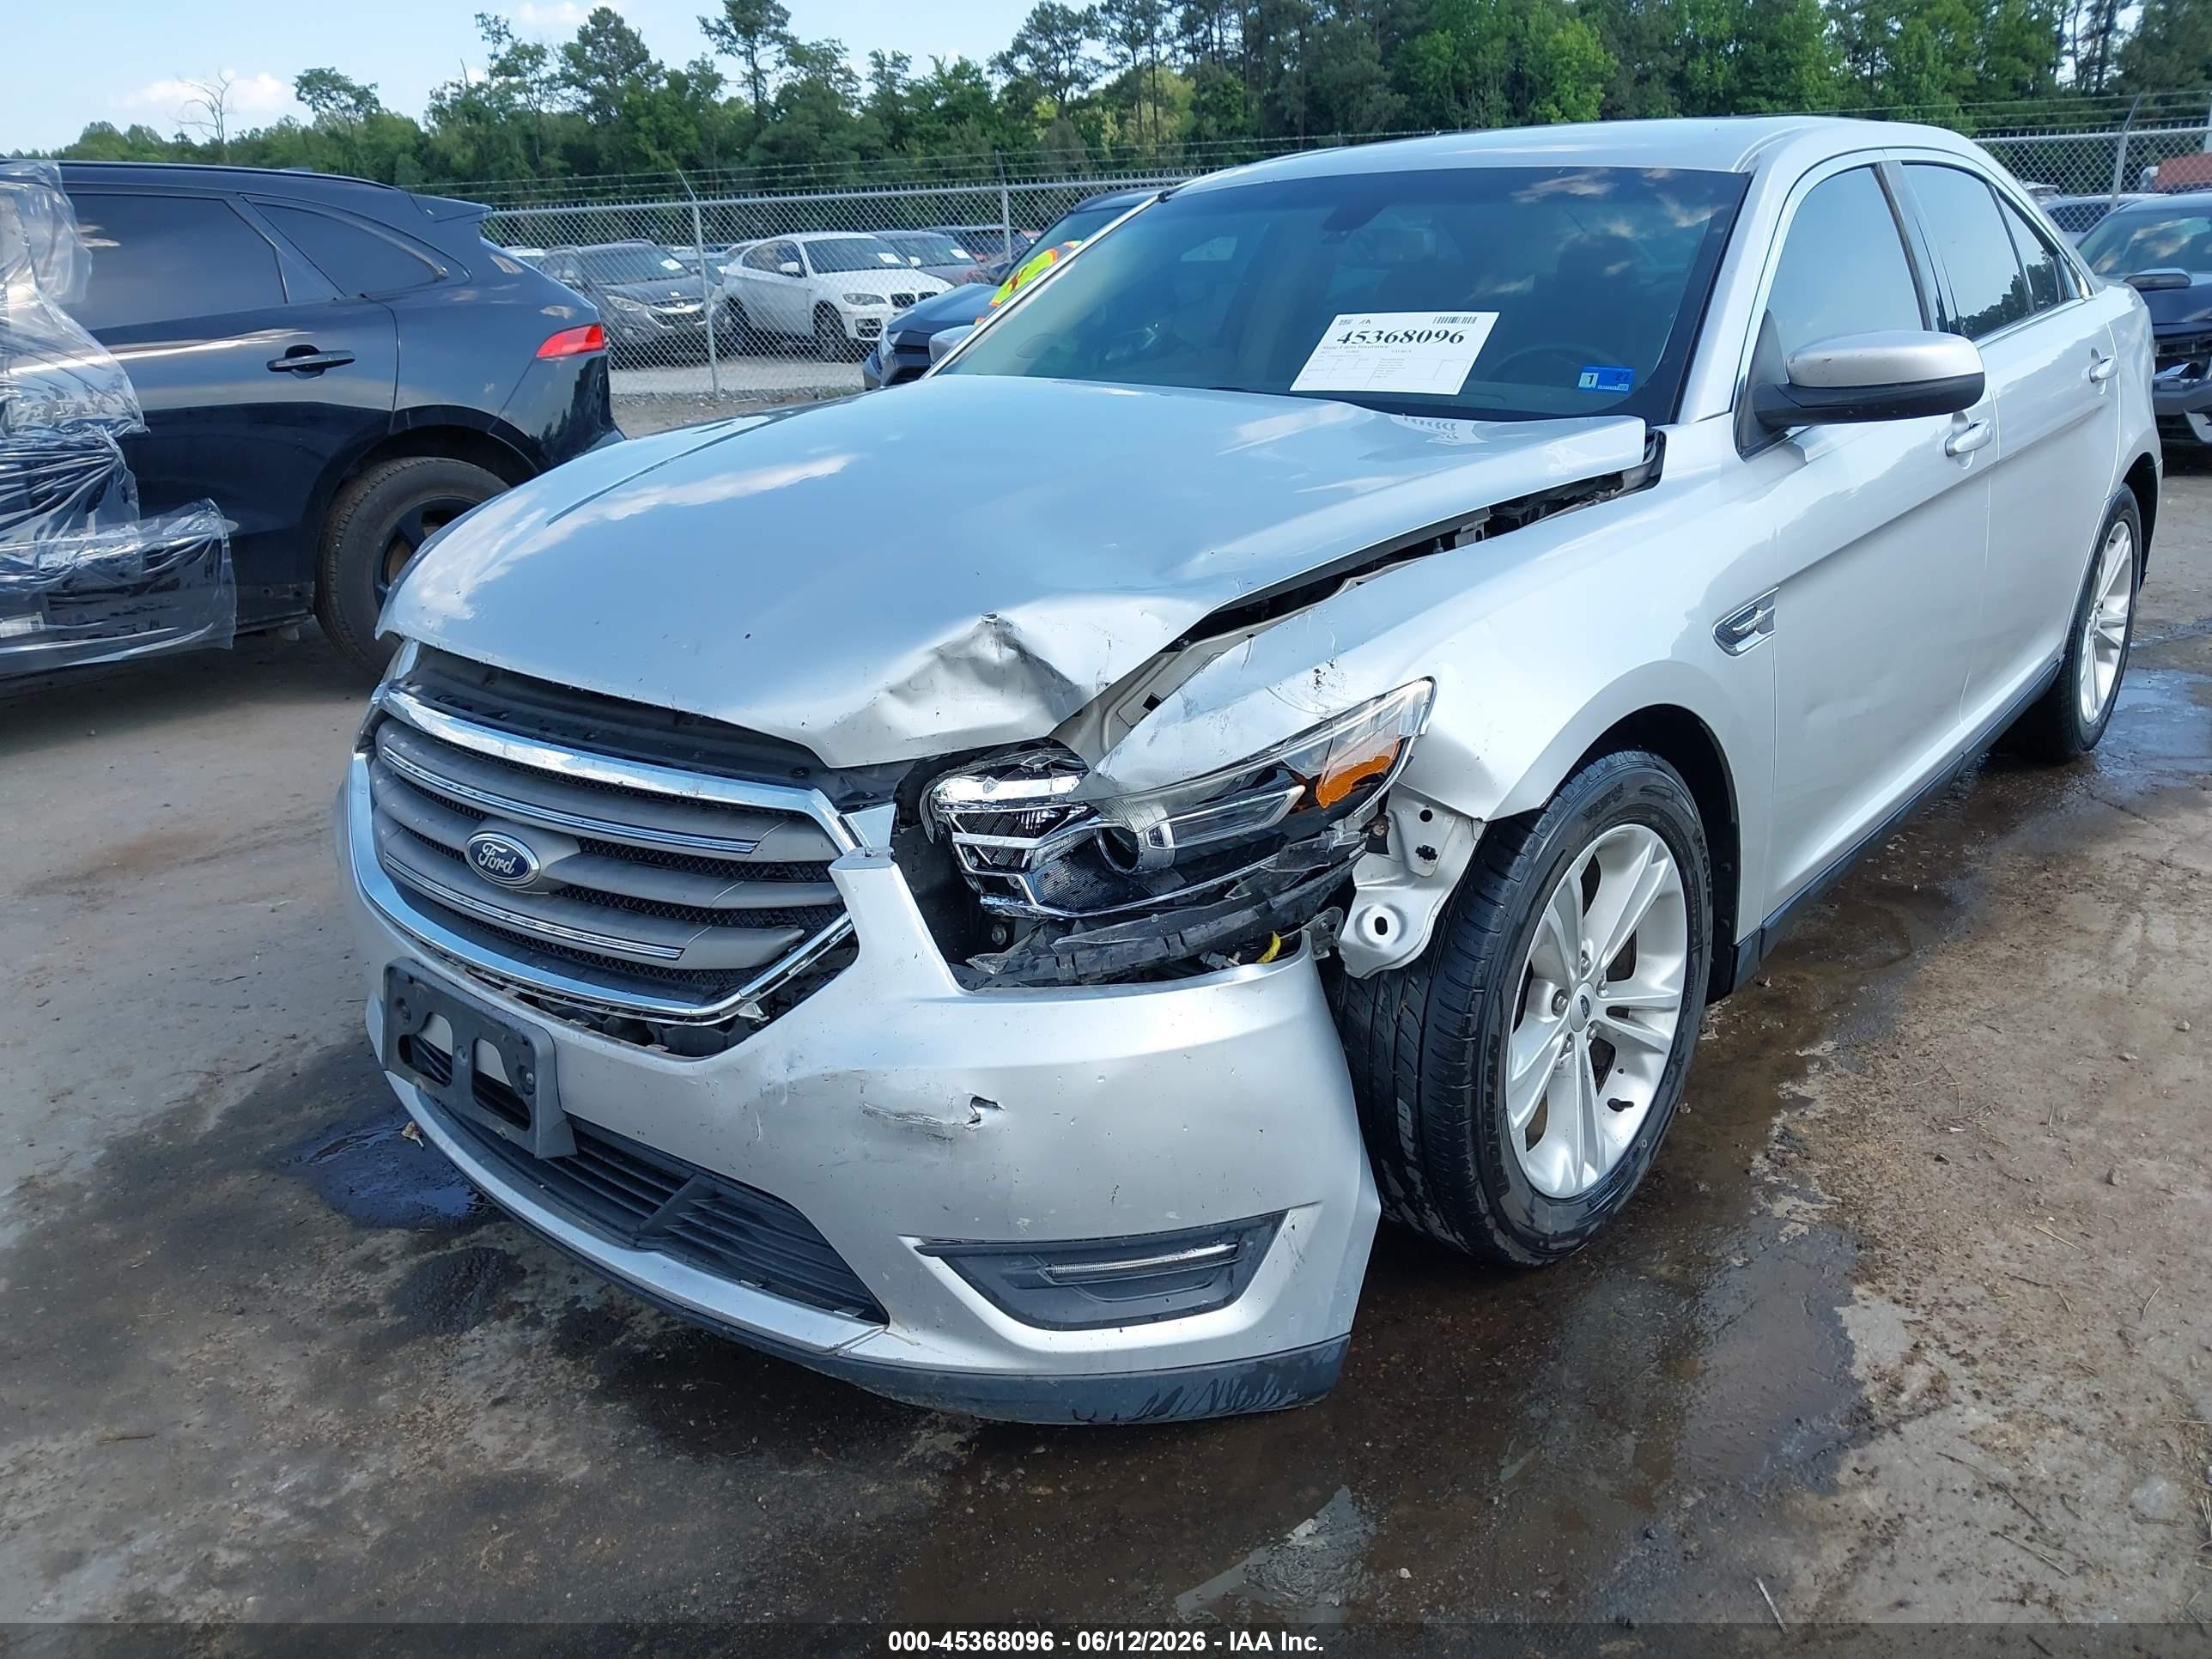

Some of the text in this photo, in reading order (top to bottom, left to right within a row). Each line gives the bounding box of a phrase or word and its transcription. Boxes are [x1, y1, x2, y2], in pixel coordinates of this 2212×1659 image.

[1337, 329, 1468, 344] 45368096
[1588, 374, 1595, 386] 1
[477, 842, 517, 875] Ford
